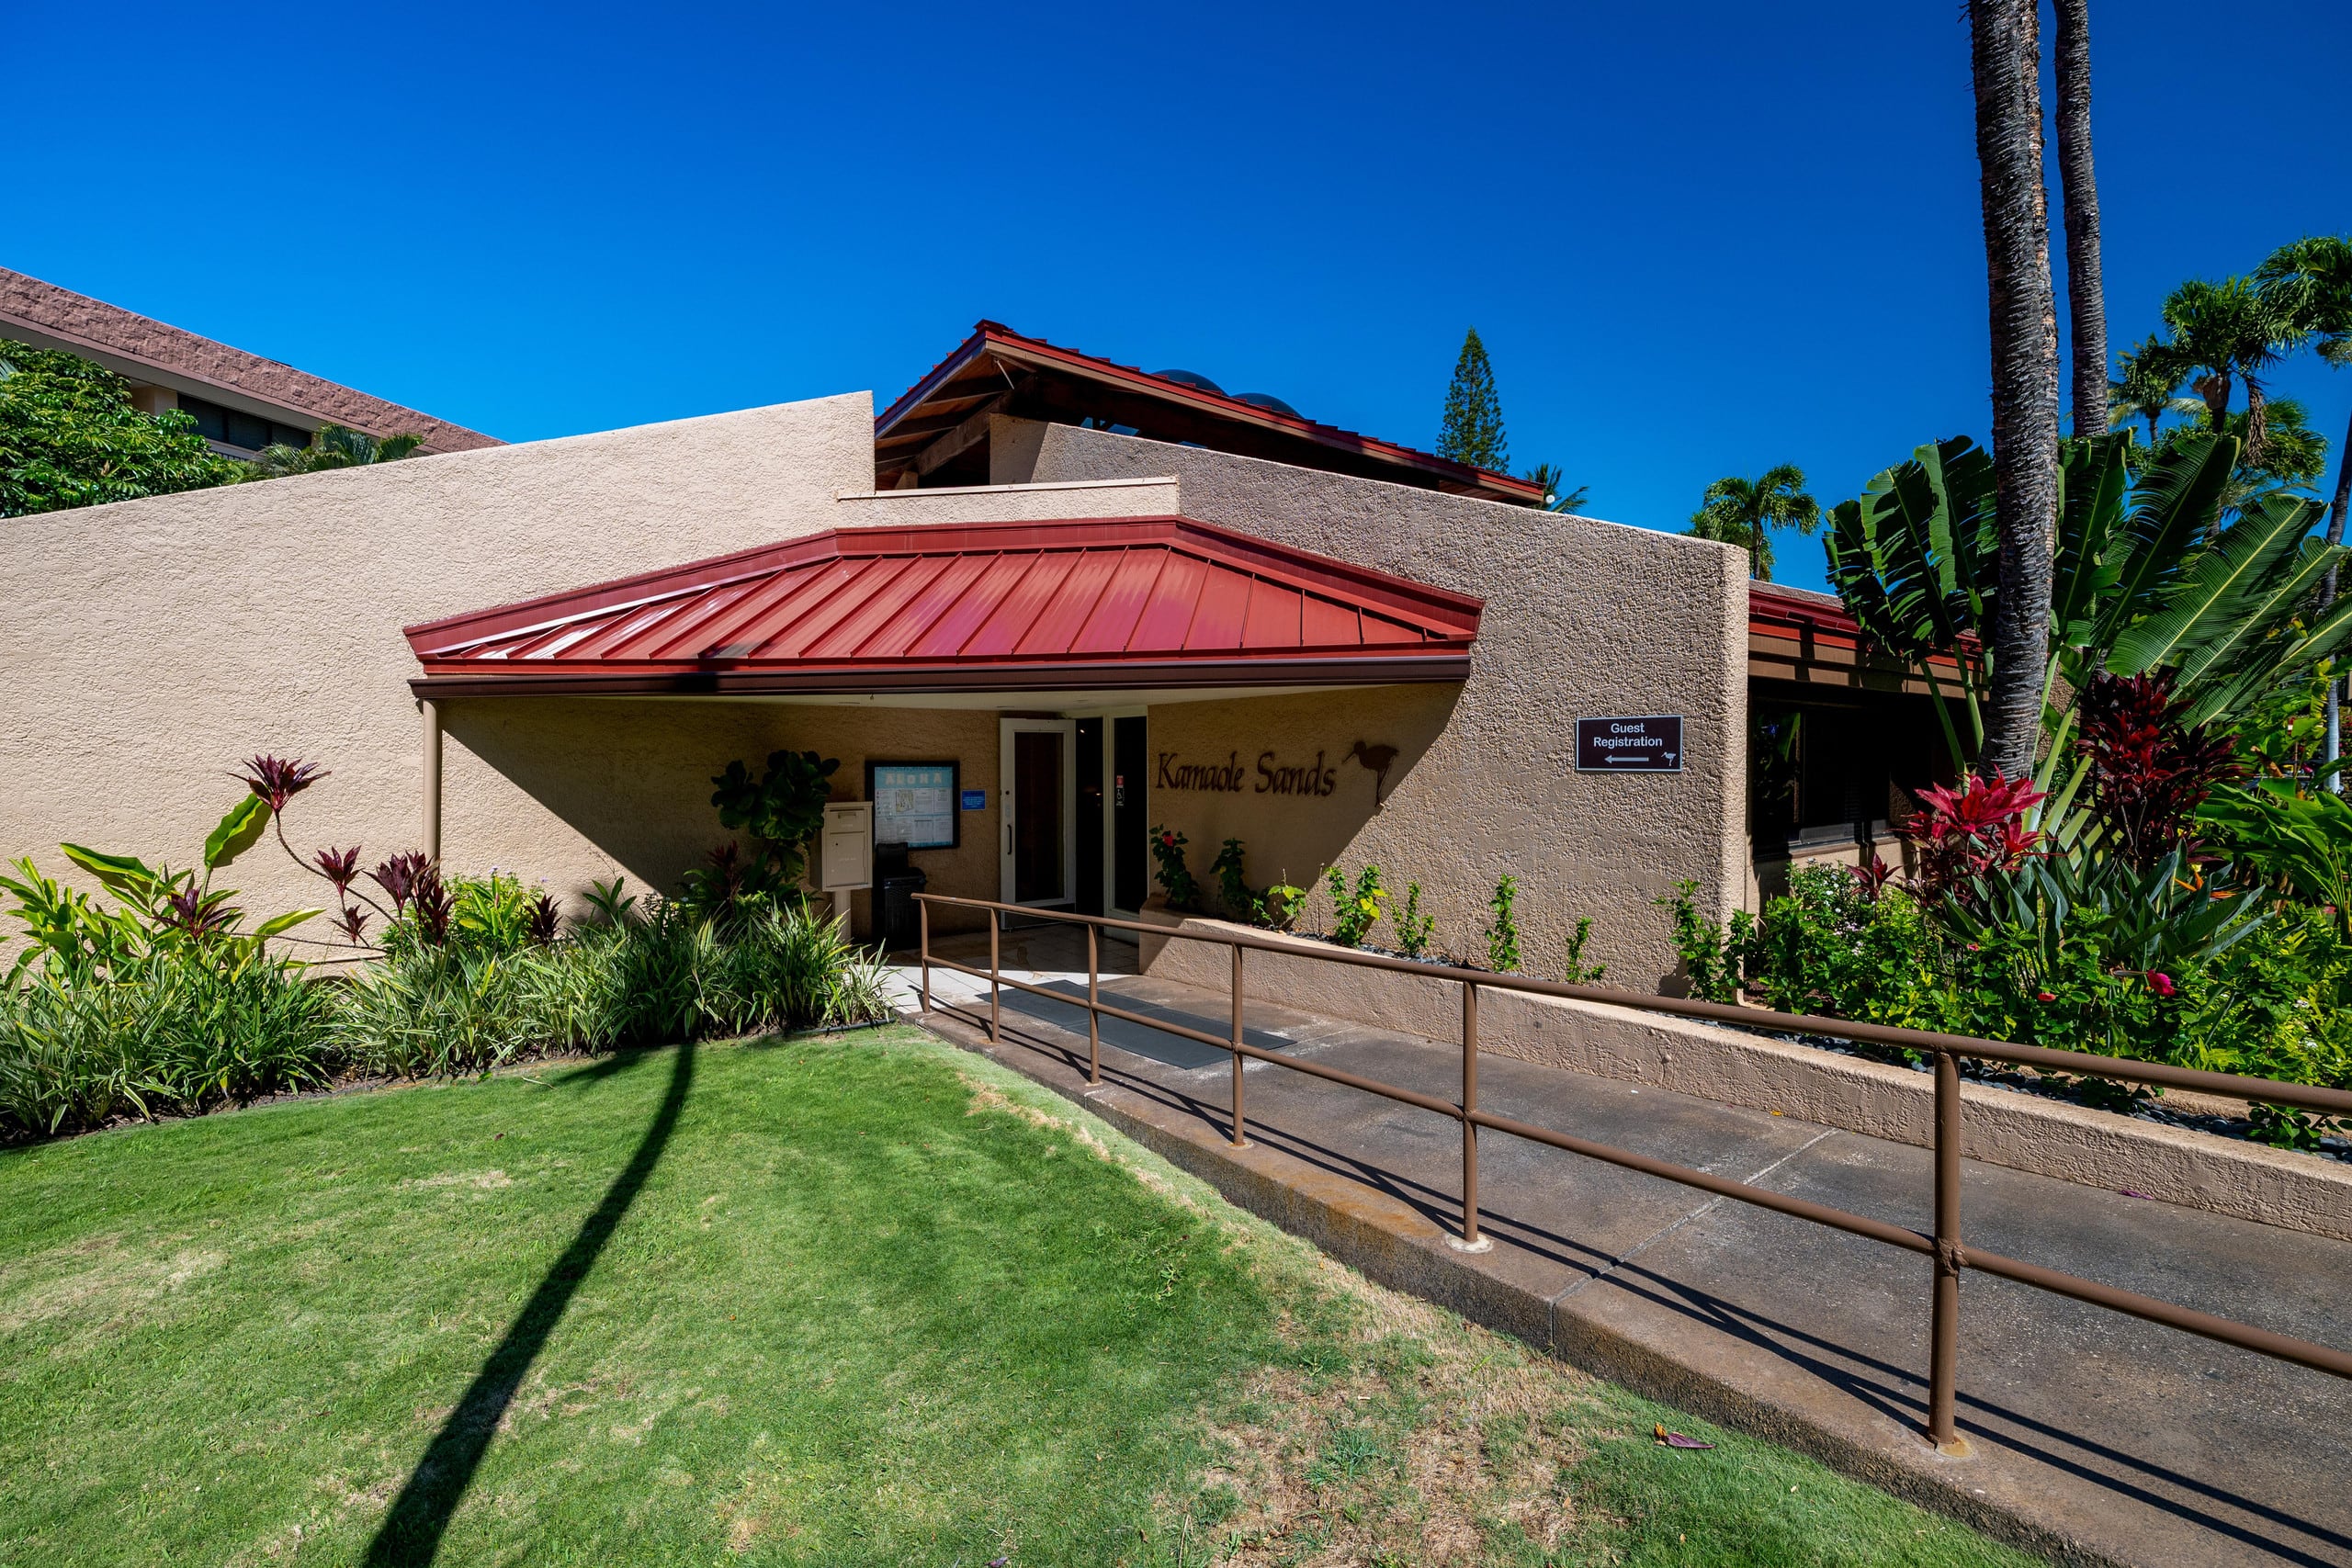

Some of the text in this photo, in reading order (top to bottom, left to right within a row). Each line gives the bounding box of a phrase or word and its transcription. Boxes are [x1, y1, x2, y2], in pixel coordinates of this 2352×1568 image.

[1611, 722, 1645, 734] Guest
[1593, 736, 1663, 750] Registration
[1156, 750, 1245, 793] Kamaole
[1254, 750, 1337, 797] Sands
